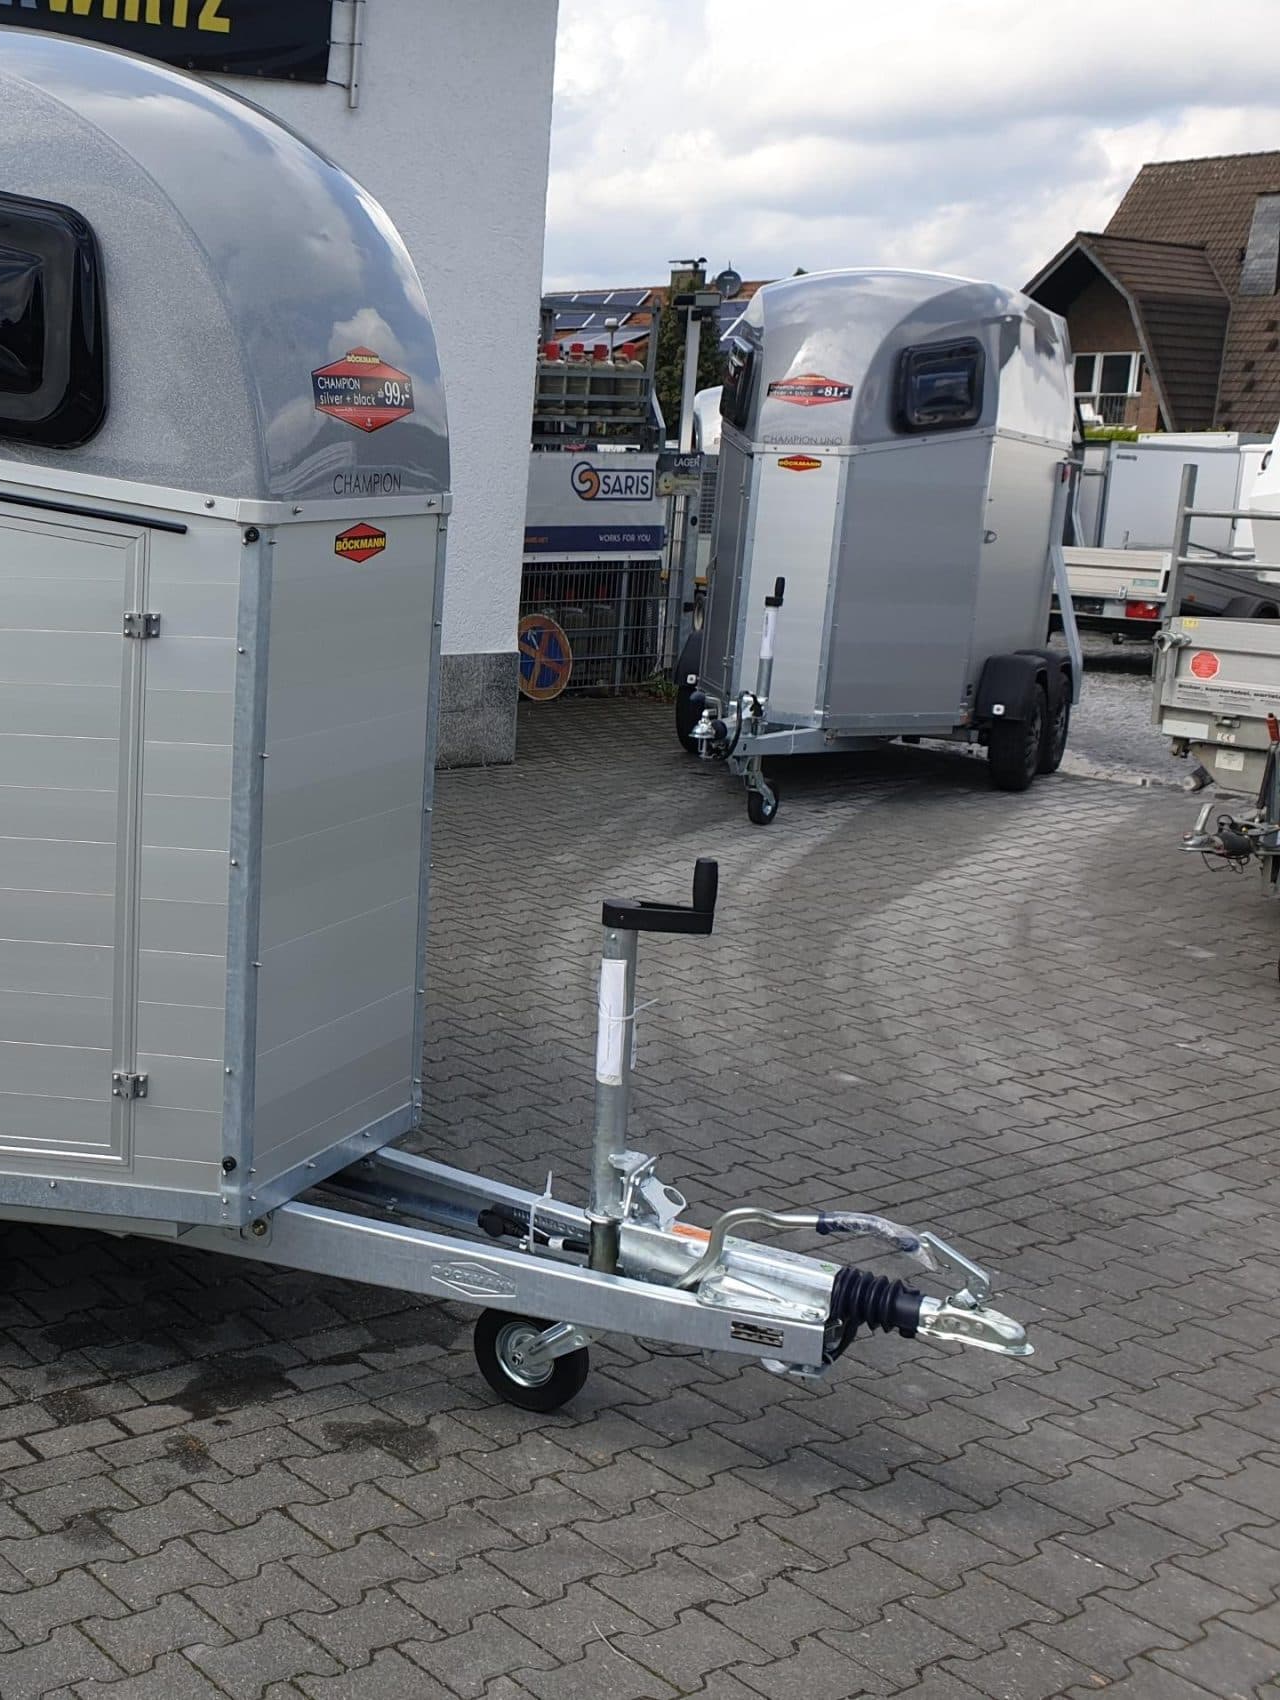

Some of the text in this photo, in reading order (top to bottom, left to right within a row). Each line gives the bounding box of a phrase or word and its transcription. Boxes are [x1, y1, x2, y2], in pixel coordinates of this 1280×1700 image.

[317, 377, 361, 390] CHAMPION
[320, 392, 343, 405] silver
[353, 393, 376, 406] black
[333, 473, 402, 494] CHAMPION
[601, 474, 650, 496] SARIS
[336, 537, 385, 551] BÖCKMANN
[599, 533, 651, 542] WORKS FOR YOU
